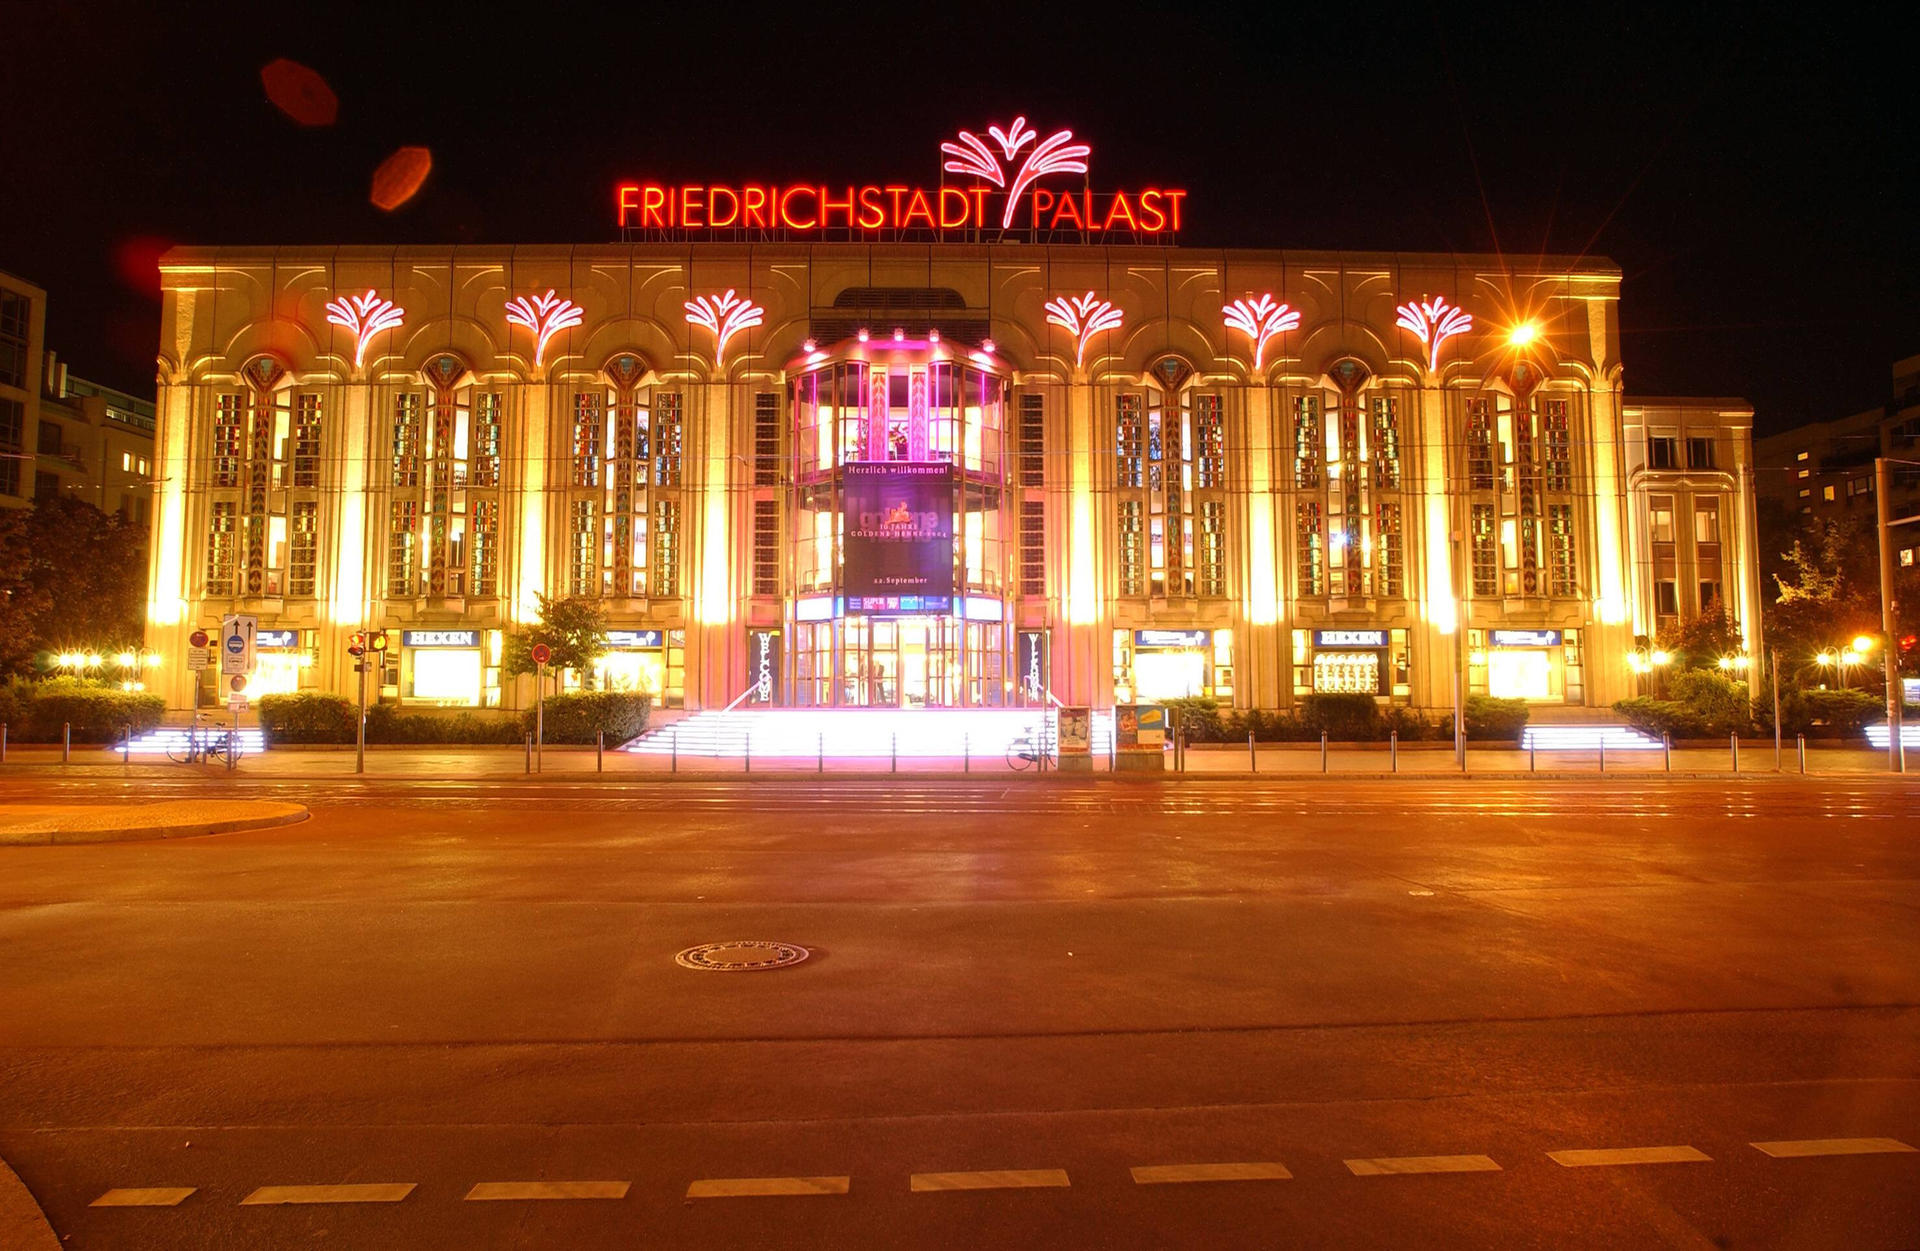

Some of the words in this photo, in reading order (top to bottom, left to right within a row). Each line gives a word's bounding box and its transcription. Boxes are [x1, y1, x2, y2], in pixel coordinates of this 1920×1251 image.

[617, 186, 991, 228] FRIEDRICHSTADT
[1033, 189, 1187, 231] PALAST
[848, 466, 887, 474] Herzlich
[890, 465, 948, 474] willkommen!
[410, 631, 473, 645] HEXEN
[1321, 631, 1382, 645] HEXEN
[758, 633, 771, 701] WELCOME
